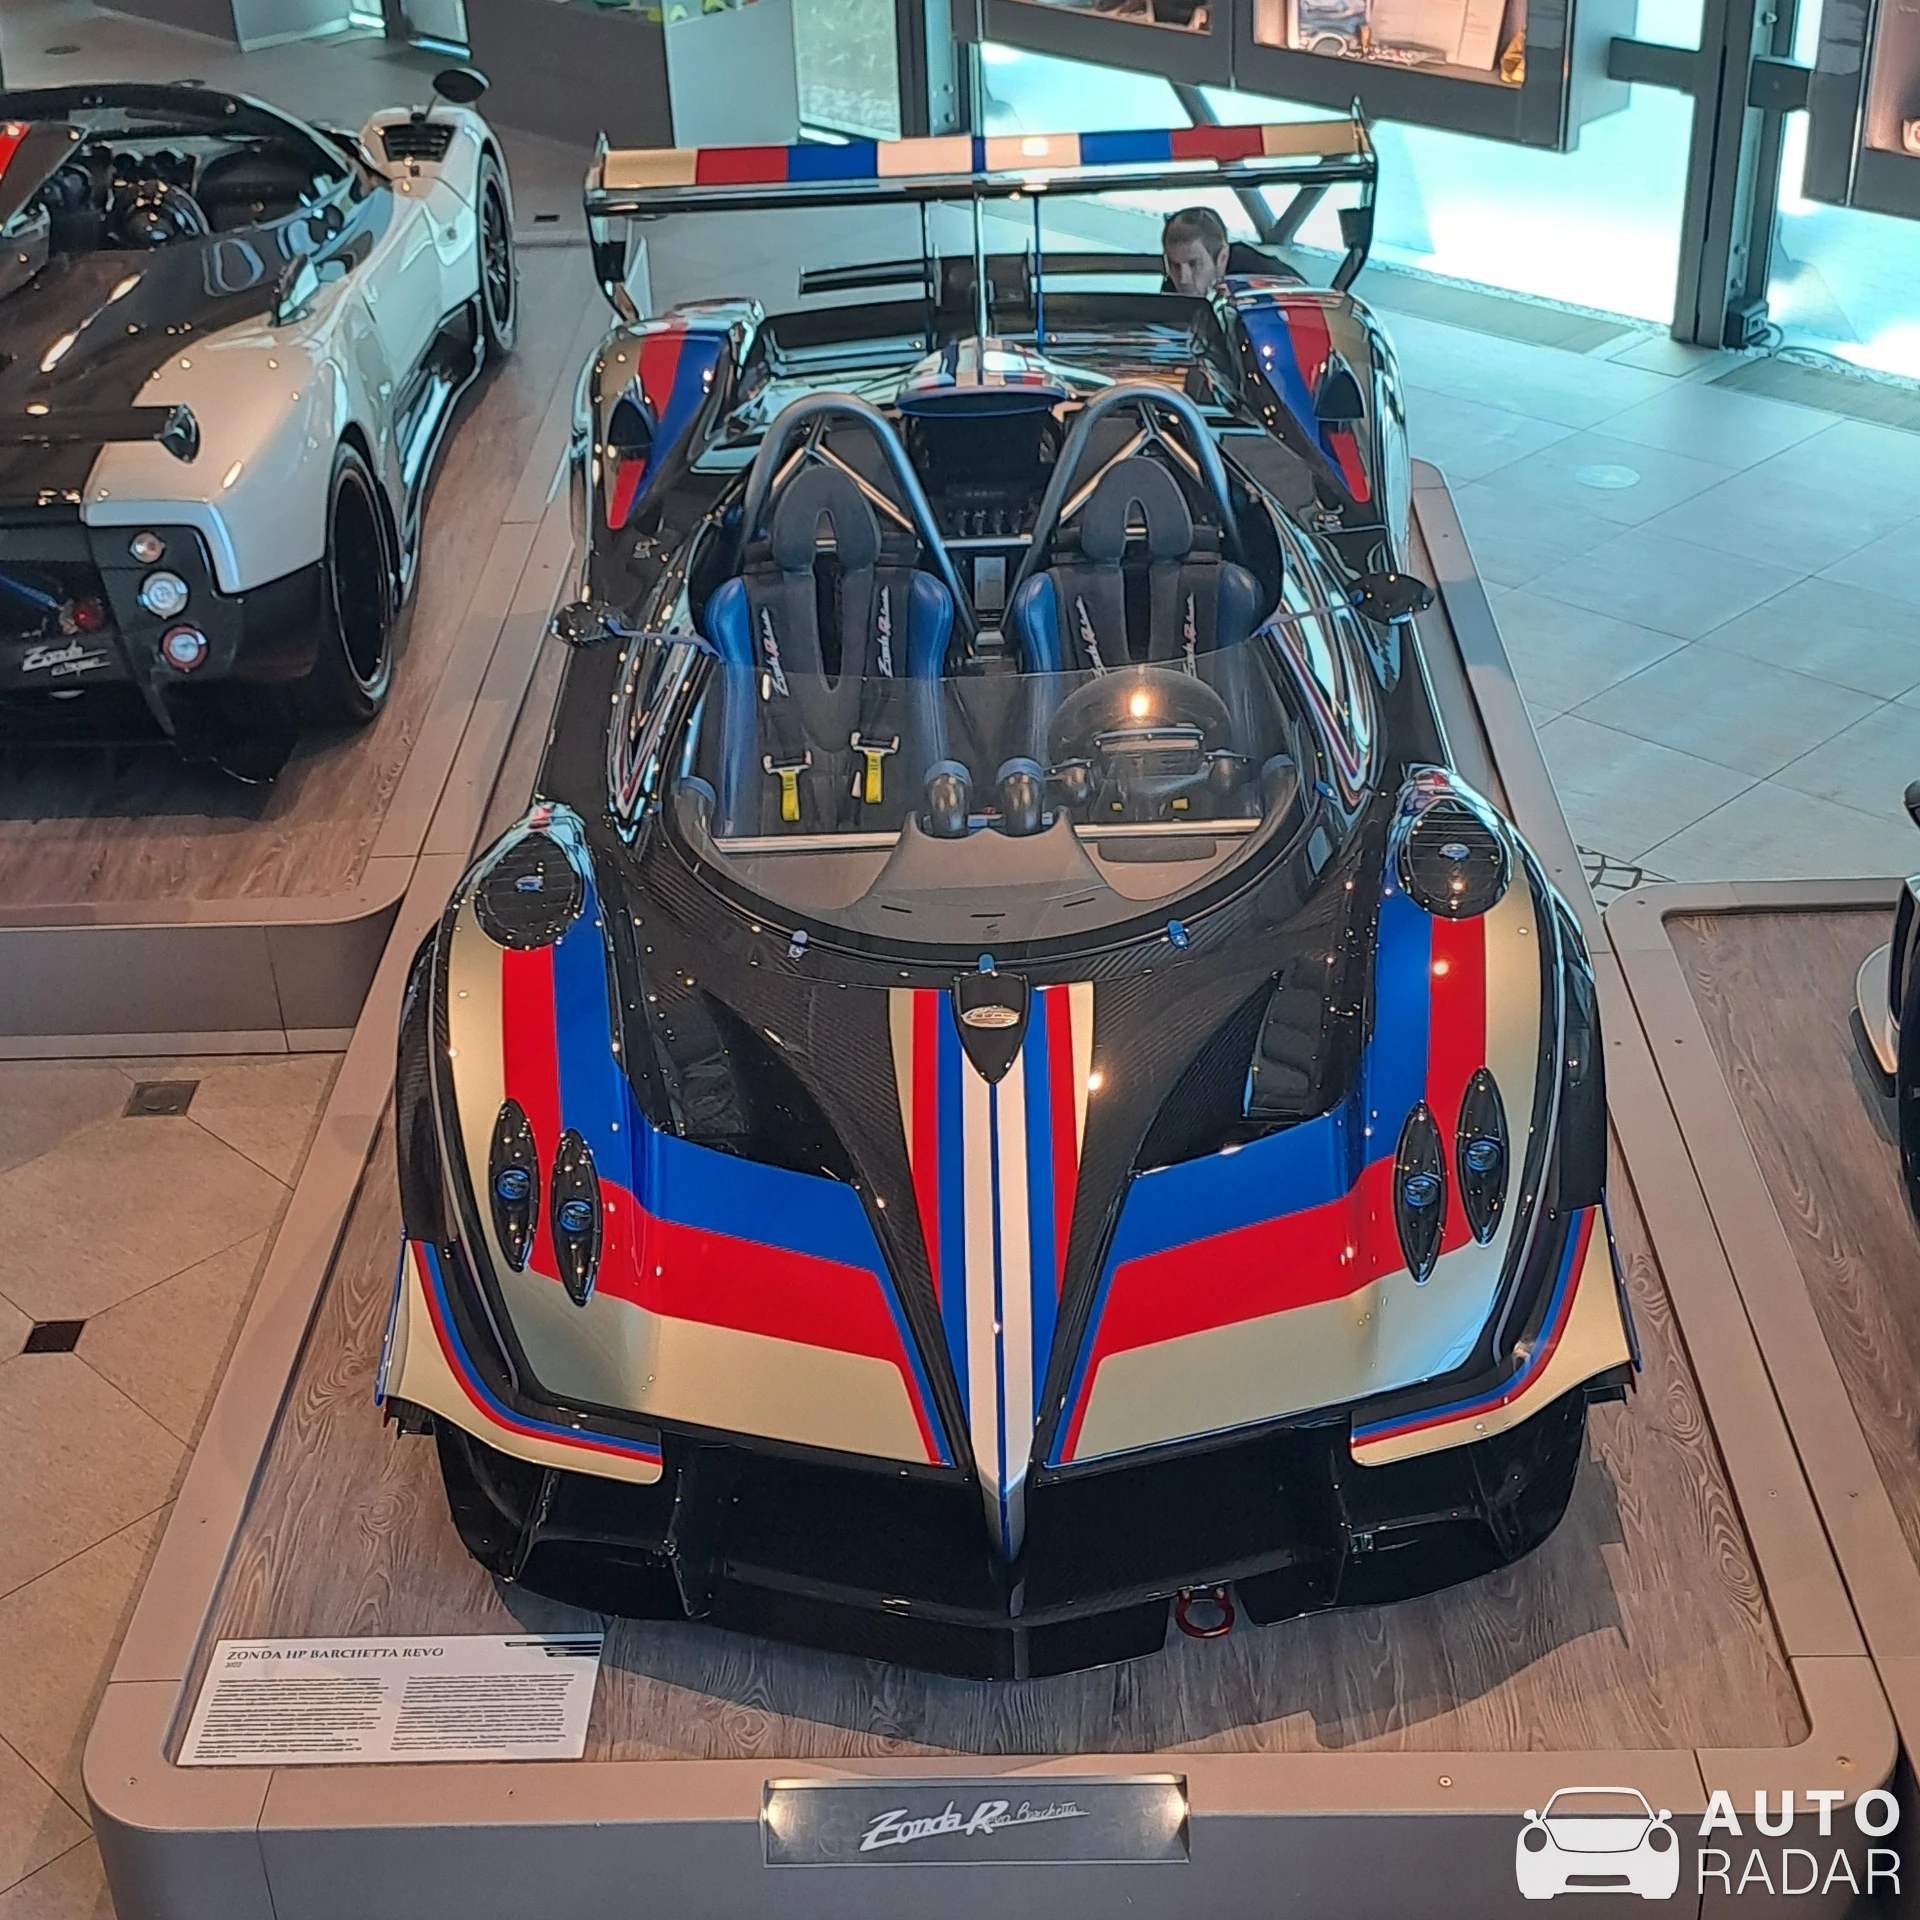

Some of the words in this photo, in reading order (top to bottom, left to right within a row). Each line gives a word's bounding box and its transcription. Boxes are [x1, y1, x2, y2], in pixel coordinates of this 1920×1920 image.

[226, 1650, 282, 1660] ZONDA
[286, 1650, 308, 1659] HP
[310, 1648, 398, 1659] BARCHETTA
[402, 1647, 444, 1657] REVO
[859, 1801, 966, 1851] Zonda
